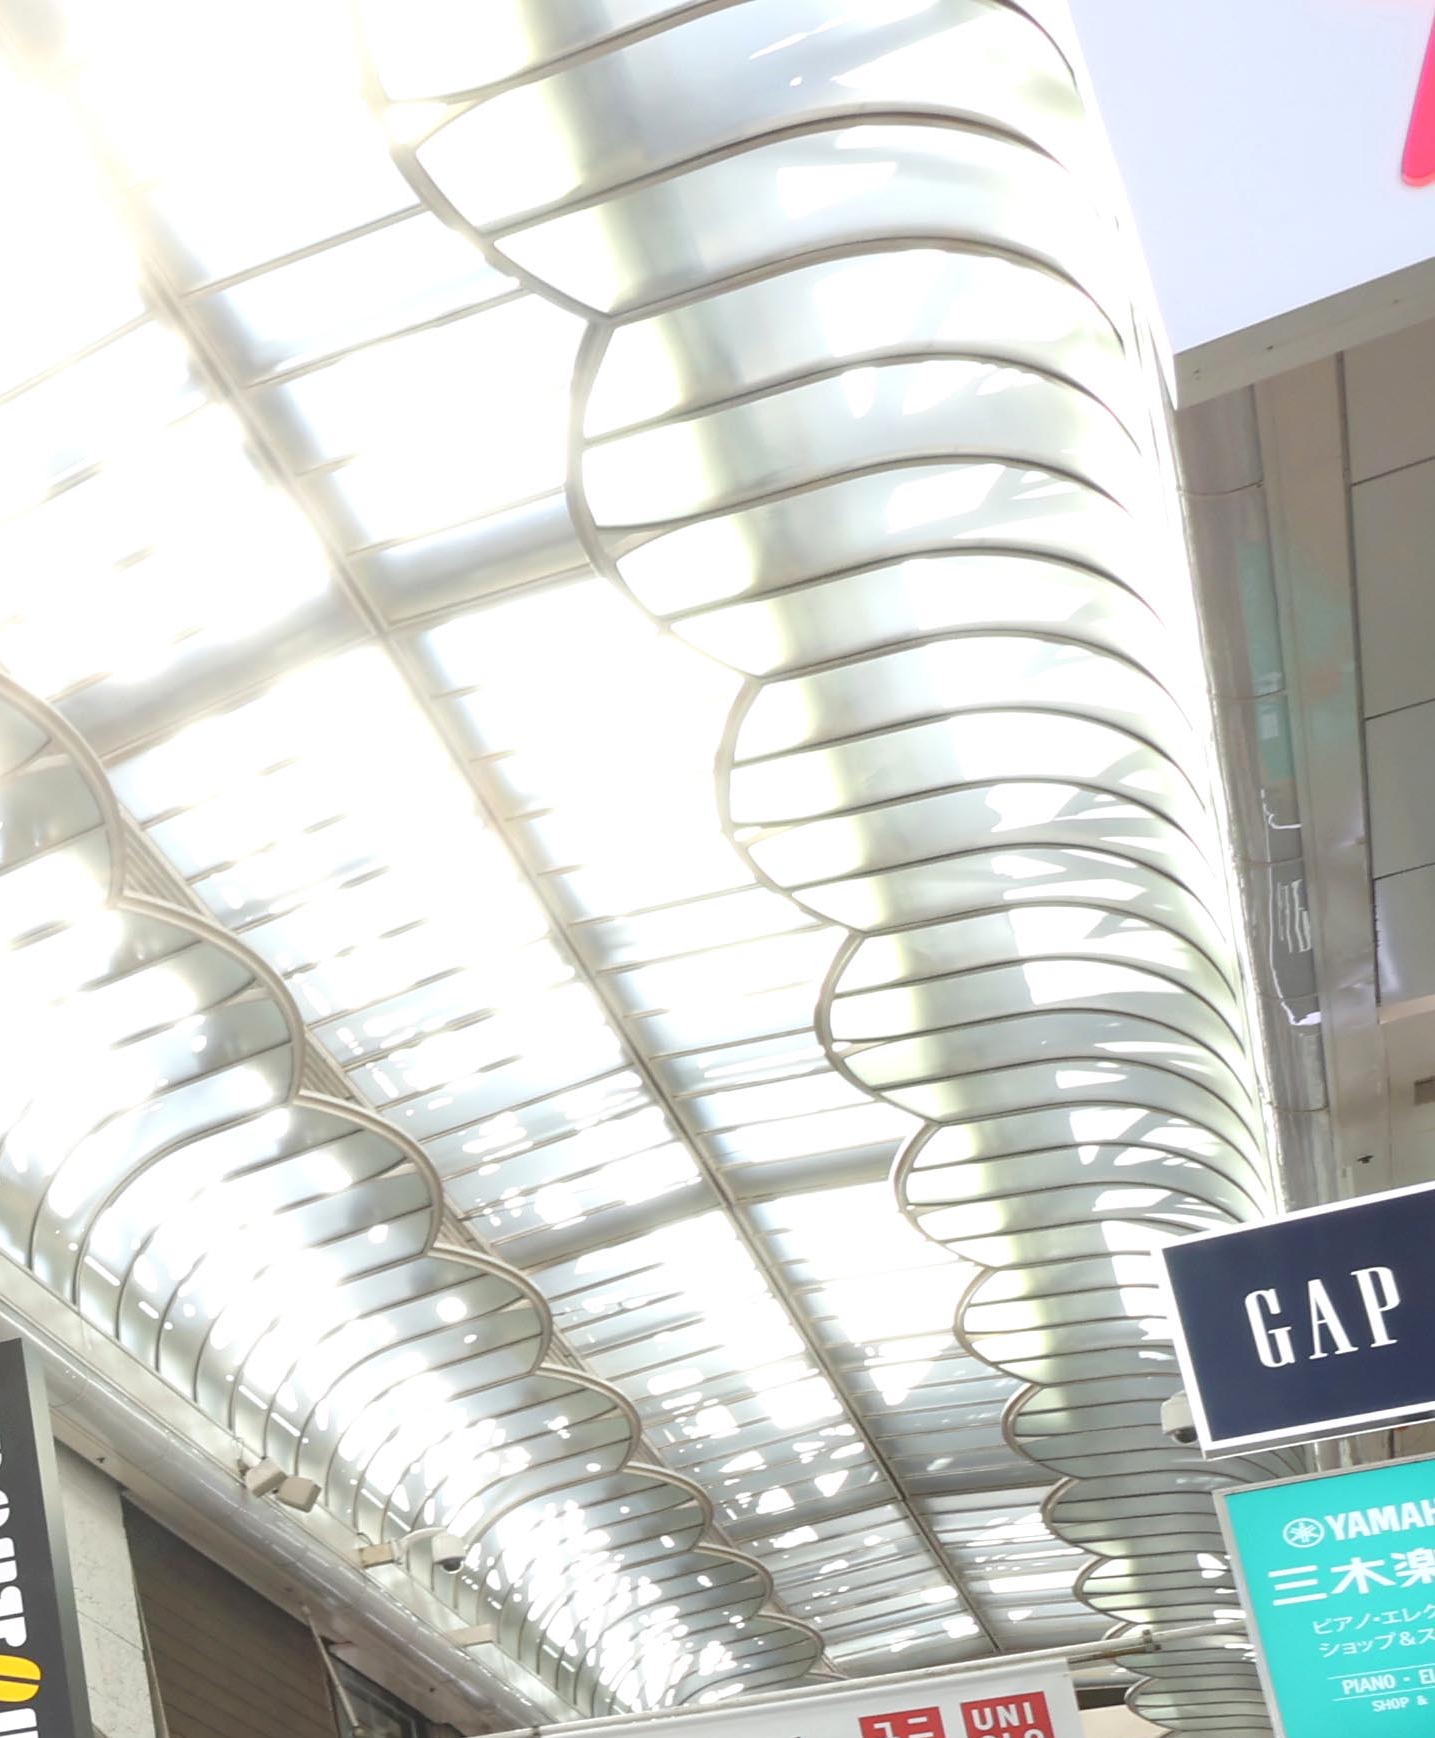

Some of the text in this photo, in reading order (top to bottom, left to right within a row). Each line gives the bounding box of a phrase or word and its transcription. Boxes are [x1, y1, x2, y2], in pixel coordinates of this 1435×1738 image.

[1244, 1266, 1402, 1370] GAP
[1342, 1673, 1395, 1697] PIANO
[1372, 1694, 1410, 1713] SHOP
[972, 1702, 1035, 1733] UNI
